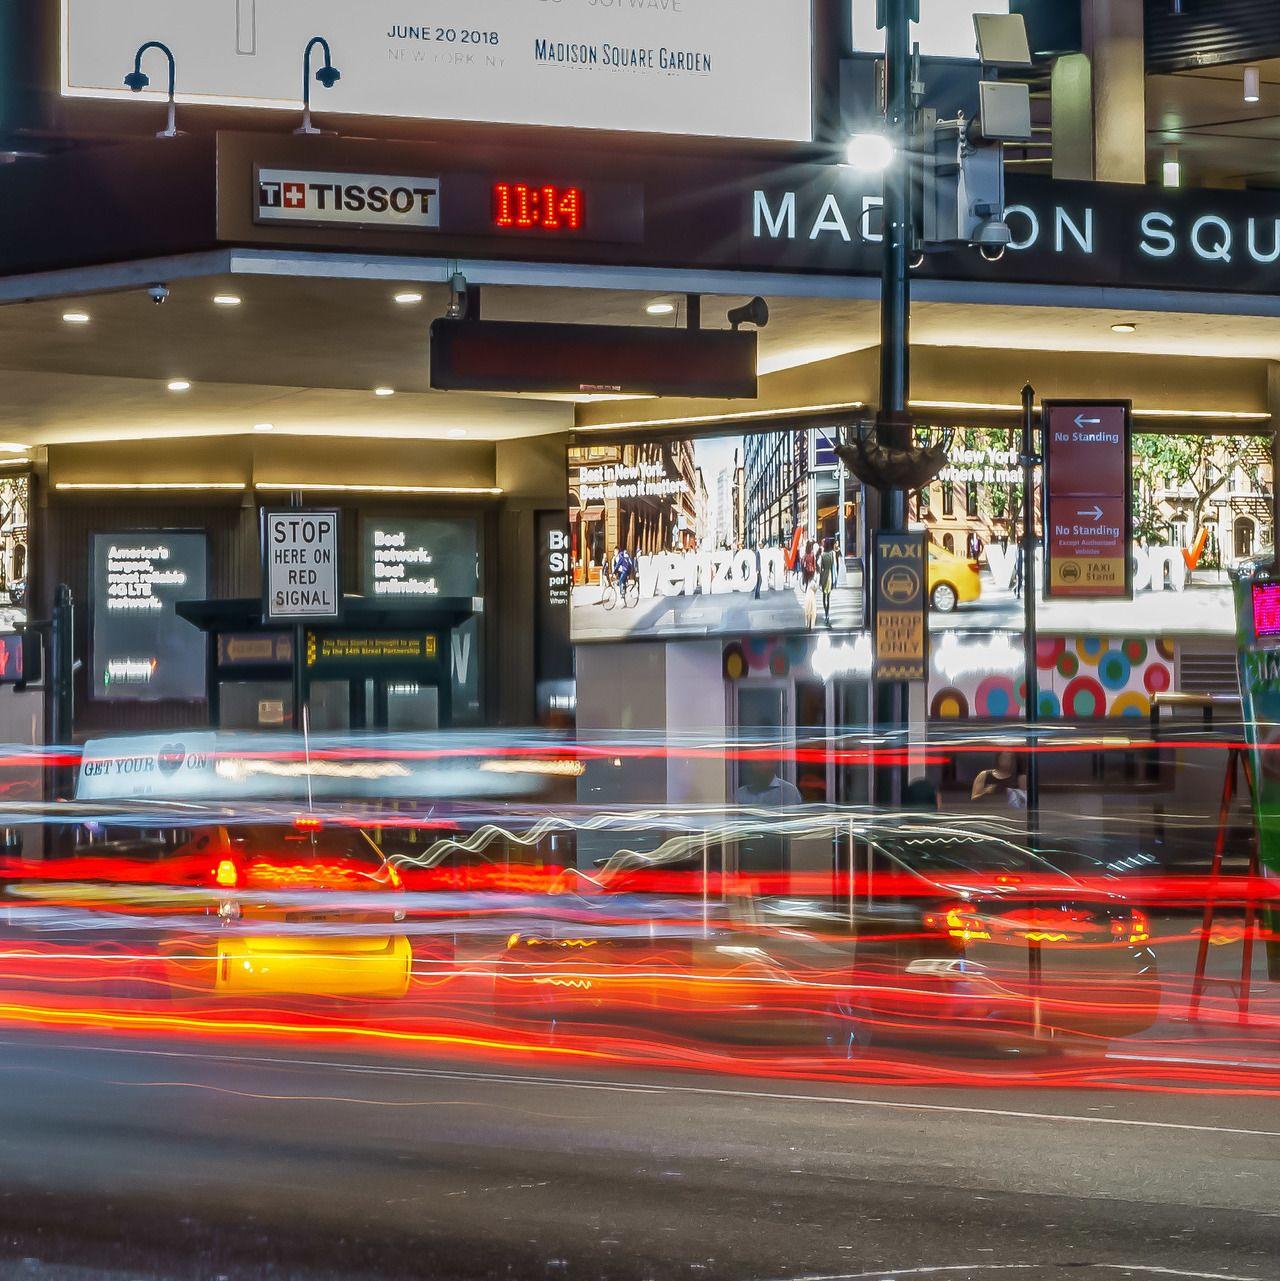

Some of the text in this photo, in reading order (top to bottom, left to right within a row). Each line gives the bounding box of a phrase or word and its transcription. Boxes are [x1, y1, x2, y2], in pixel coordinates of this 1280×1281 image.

[387, 25, 499, 45] JUNE 20 2018
[535, 38, 597, 64] MADISON
[602, 43, 654, 68] SQUARE
[659, 47, 712, 72] GARDEN
[310, 183, 436, 214] TISSOT
[494, 181, 579, 228] 11:14
[1055, 431, 1119, 444] No Standing
[274, 521, 331, 543] STOP
[1055, 525, 1120, 538] No Standing
[275, 549, 331, 564] HERE ON
[880, 543, 922, 559] TAXI
[1088, 563, 1111, 571] TAXI
[289, 570, 317, 585] RED
[1086, 570, 1116, 582] Stand
[128, 583, 153, 596] LTE
[276, 590, 331, 606] SIGNAL
[880, 641, 920, 654] ONLY
[84, 751, 208, 777] GET YOUR ON
